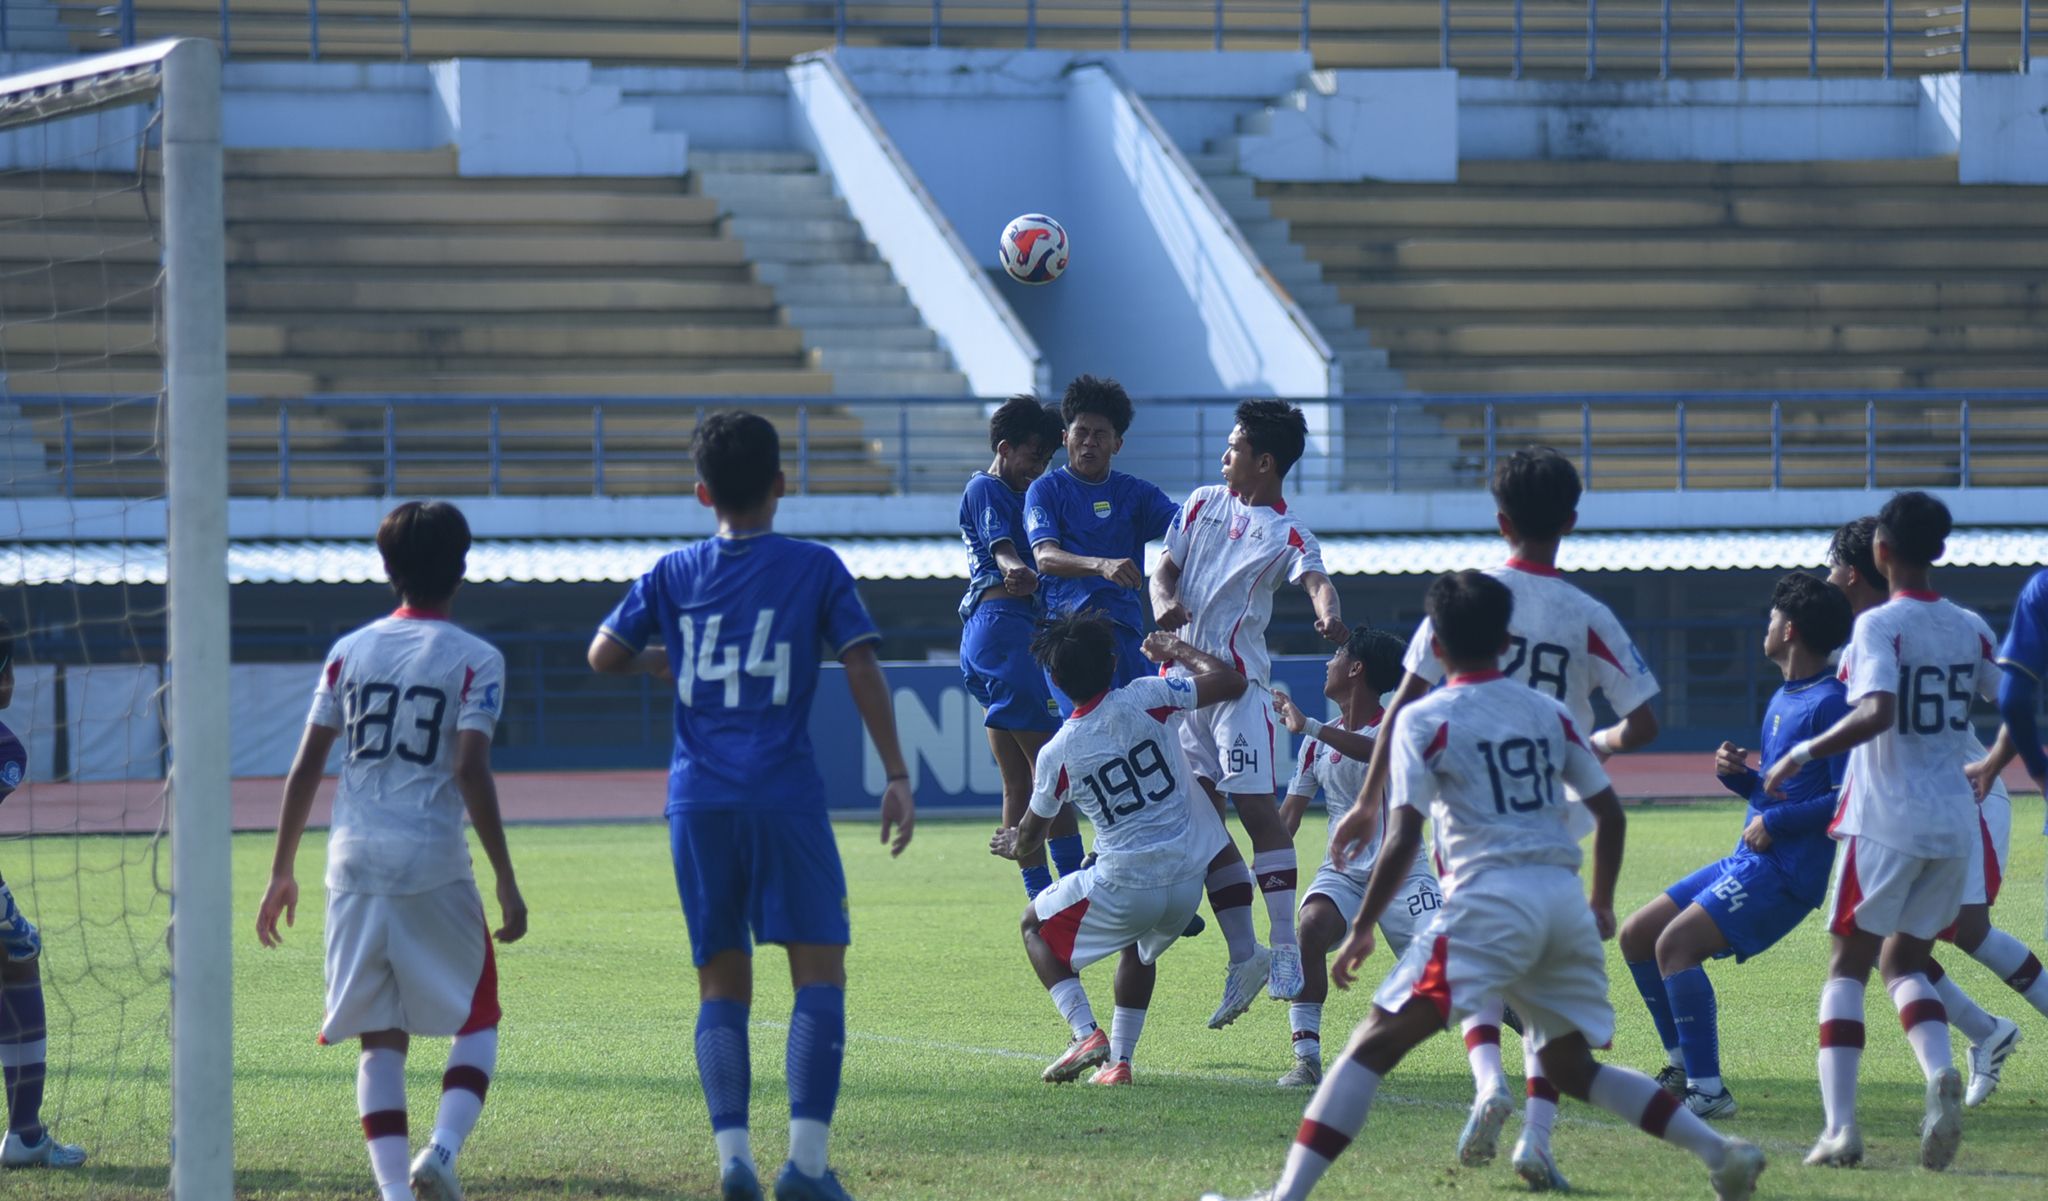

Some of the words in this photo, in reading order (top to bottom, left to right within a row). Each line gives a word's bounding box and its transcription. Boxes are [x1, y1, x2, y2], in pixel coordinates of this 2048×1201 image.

[678, 609, 790, 708] 144
[345, 682, 446, 766] 183
[1899, 664, 1974, 735] 165
[1082, 739, 1175, 825] 199
[1227, 749, 1257, 773] 194
[1477, 737, 1555, 814] 191
[1711, 875, 1749, 913] 124
